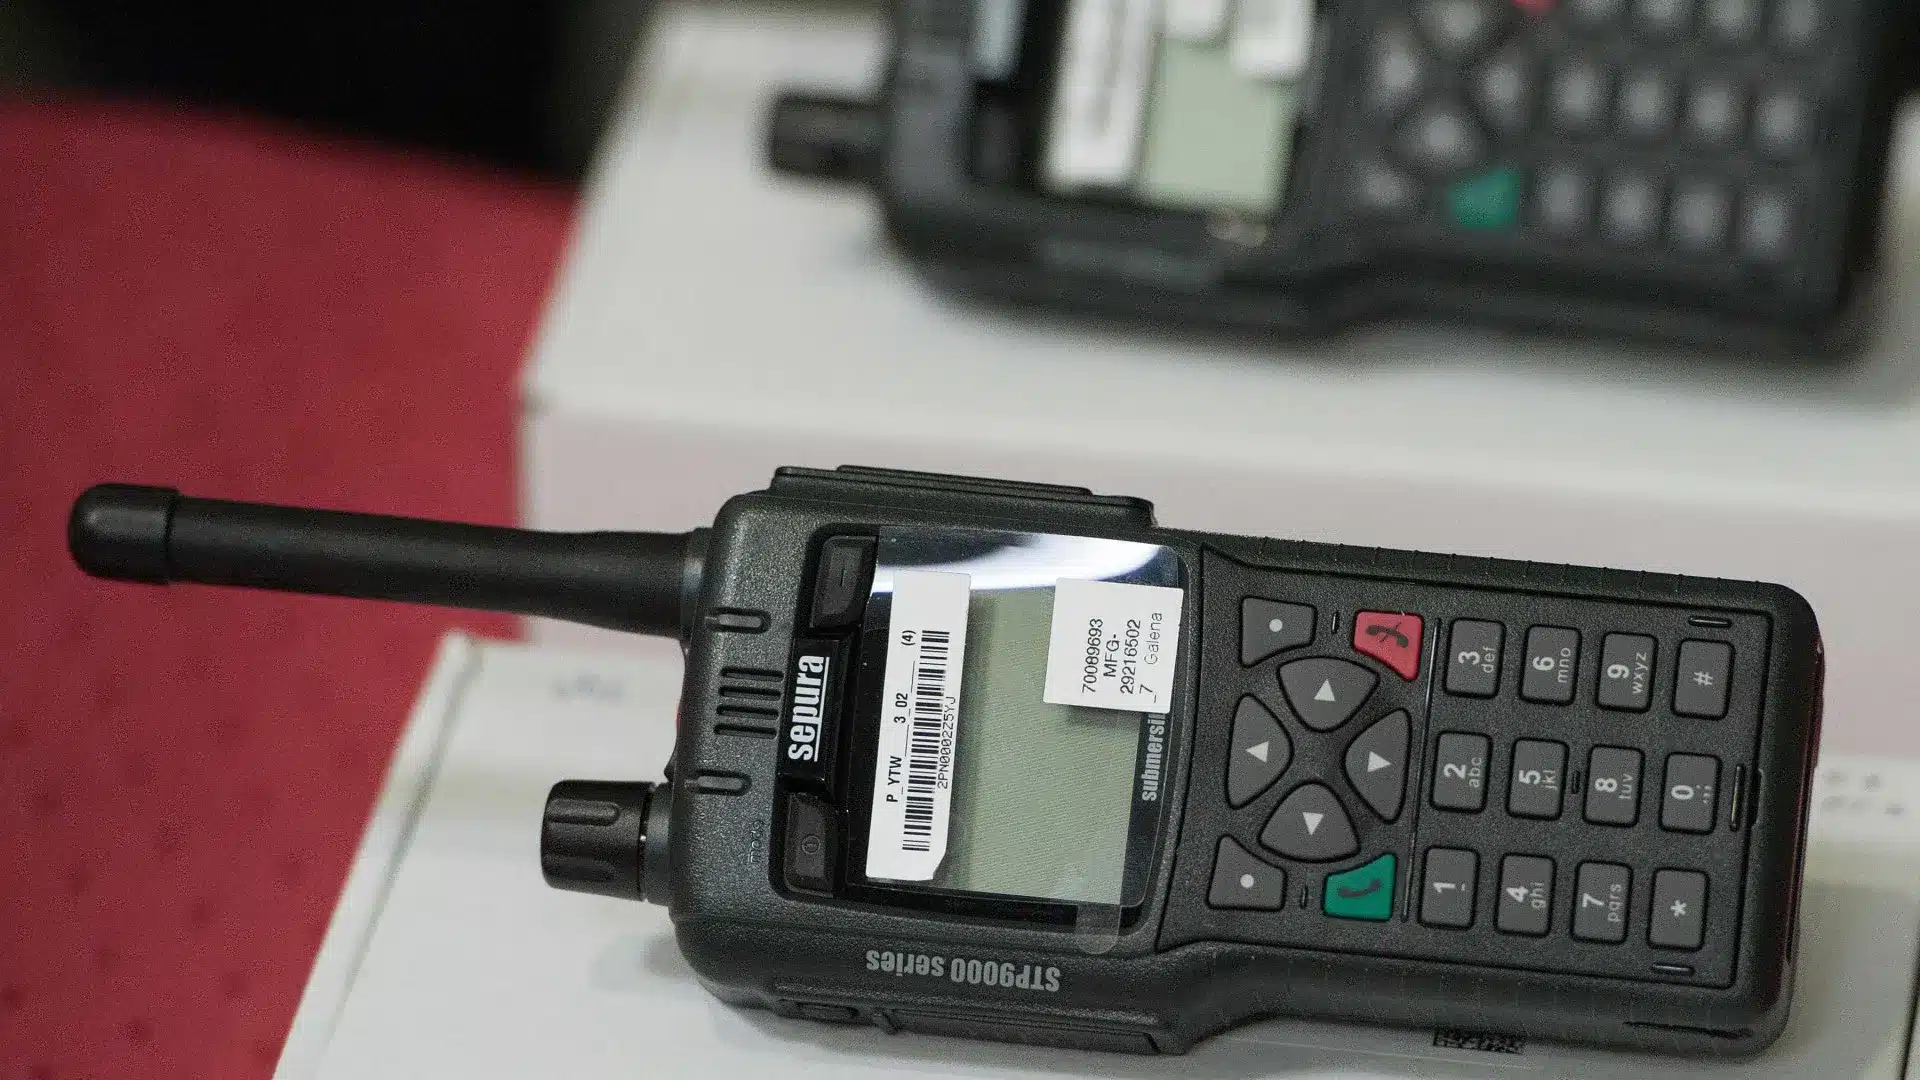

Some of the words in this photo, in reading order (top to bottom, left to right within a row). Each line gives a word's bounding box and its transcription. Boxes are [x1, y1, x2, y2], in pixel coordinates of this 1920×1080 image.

[901, 630, 917, 646] (4)
[1144, 612, 1163, 665] Galena
[1082, 618, 1103, 693] 70089693
[1103, 634, 1120, 678] MFG-
[1120, 619, 1141, 694] 29216502
[1458, 651, 1481, 665] 3
[1481, 646, 1496, 673] def
[1532, 656, 1555, 671] 6
[1557, 647, 1572, 683] mno
[1607, 664, 1630, 679] 9
[1632, 652, 1649, 694] wxyz
[1693, 670, 1713, 686] #
[788, 655, 830, 762] sepura
[1443, 763, 1467, 780] 2
[1468, 757, 1482, 788] abc
[1518, 770, 1542, 785] 5
[1541, 769, 1558, 790] jkl
[1594, 777, 1618, 793] 8
[1619, 773, 1633, 799] tuv
[1671, 785, 1695, 800] 0
[1433, 882, 1456, 894] 1
[1506, 885, 1529, 903] 4
[1530, 882, 1547, 909] ghi
[1582, 892, 1605, 908] 7
[1607, 884, 1624, 922] pqrs
[865, 949, 945, 977] series
[950, 957, 1061, 993] STP9000
